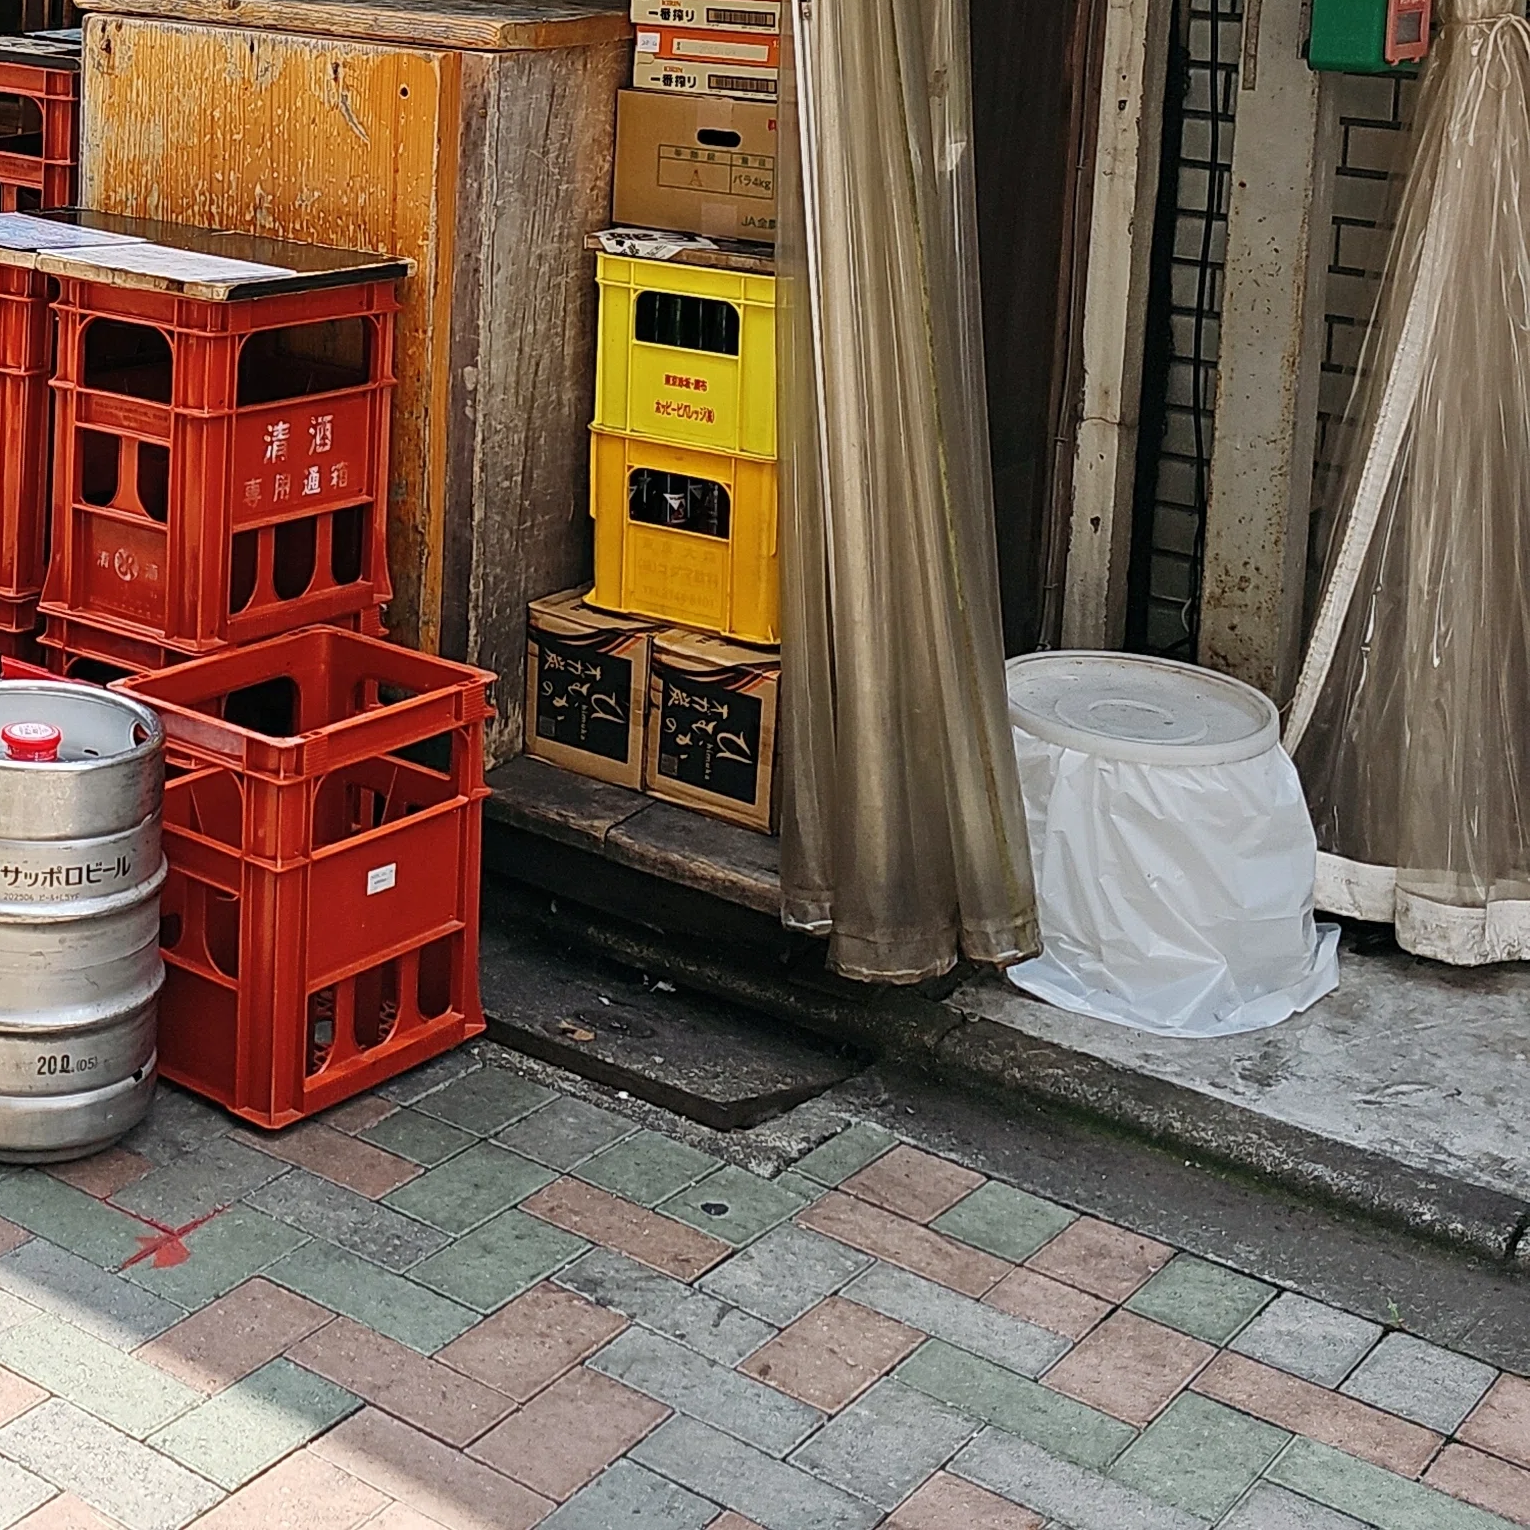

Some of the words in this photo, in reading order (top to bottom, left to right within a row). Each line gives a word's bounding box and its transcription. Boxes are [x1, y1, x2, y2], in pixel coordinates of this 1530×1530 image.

[648, 8, 695, 22] 一番搾り
[650, 74, 697, 88] 一番搾り
[264, 414, 334, 464] 清酒
[0, 856, 132, 887] サッポロビール
